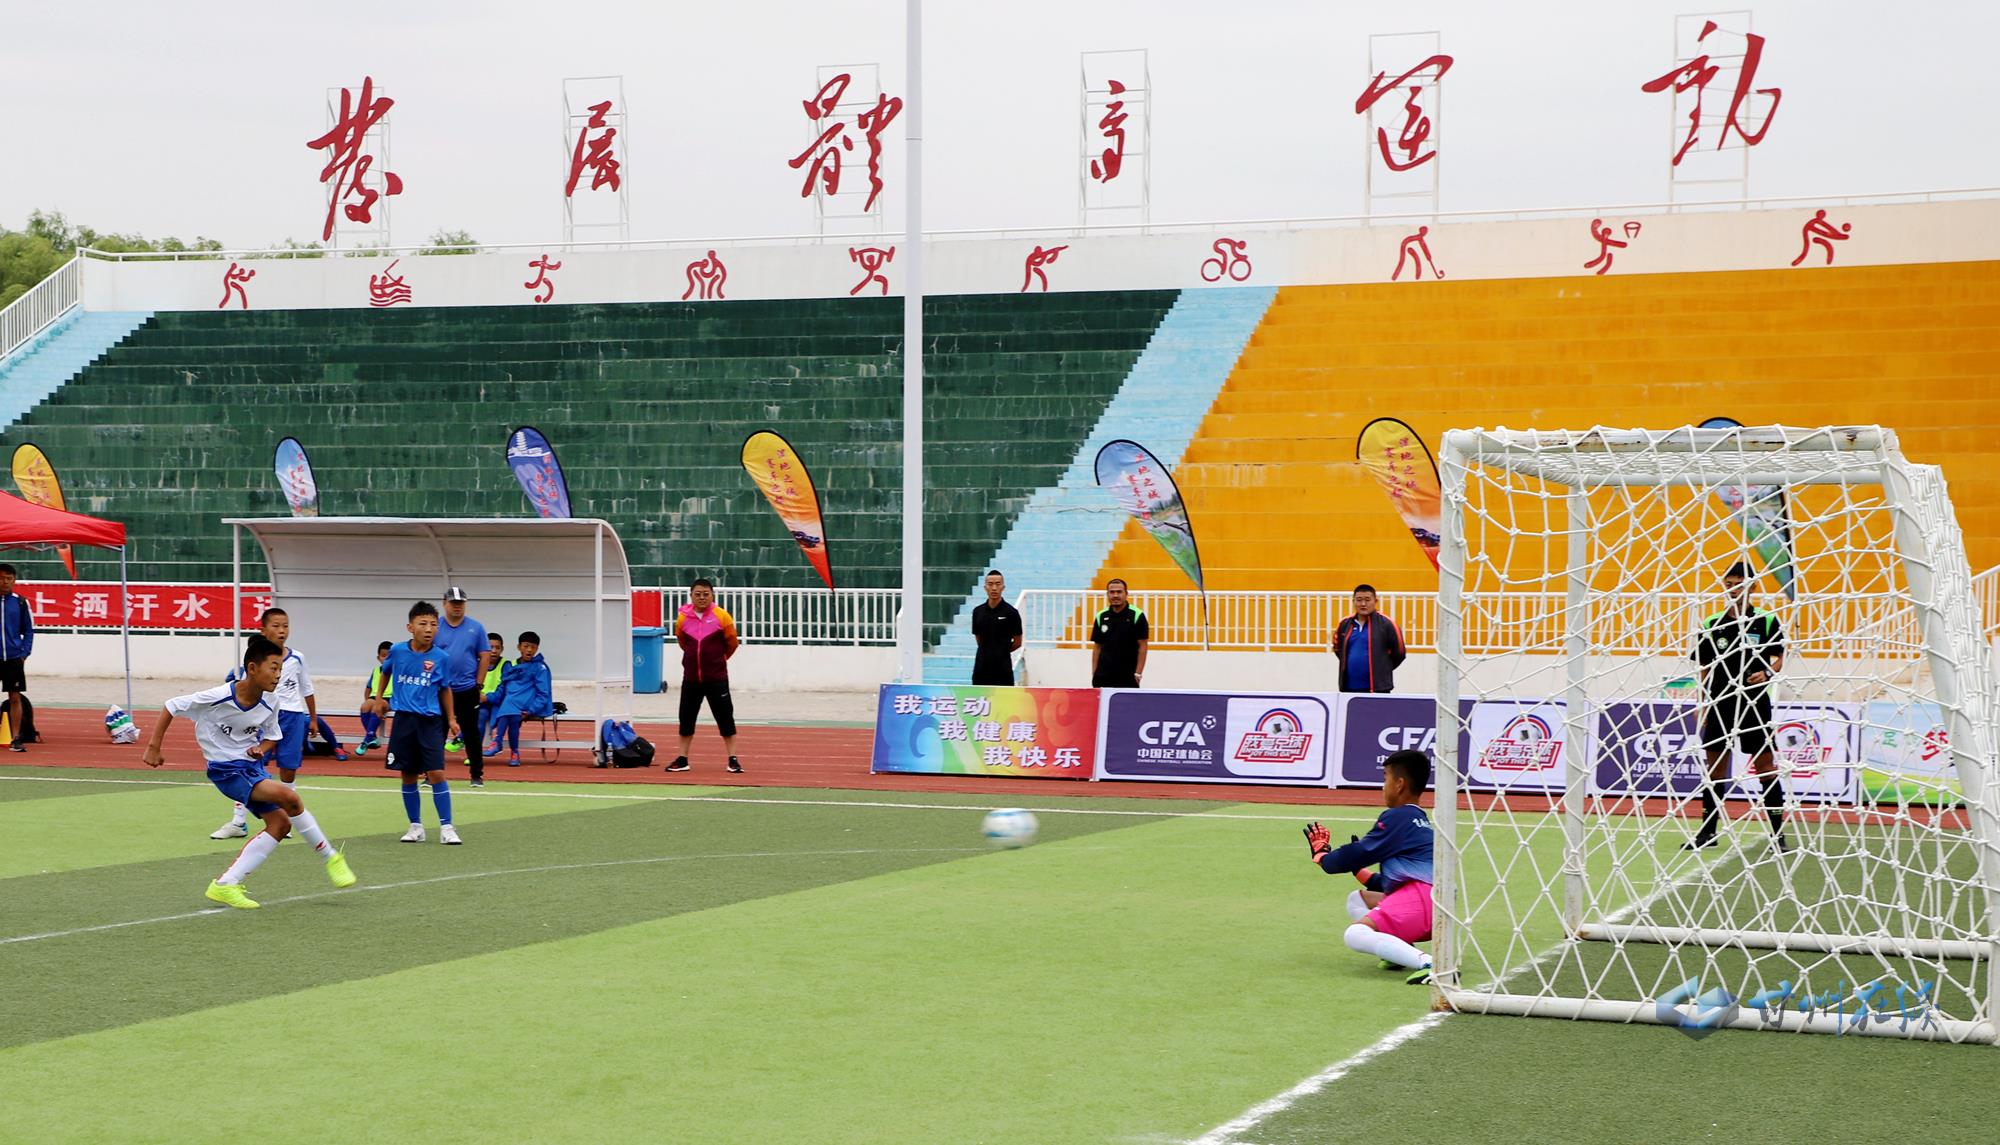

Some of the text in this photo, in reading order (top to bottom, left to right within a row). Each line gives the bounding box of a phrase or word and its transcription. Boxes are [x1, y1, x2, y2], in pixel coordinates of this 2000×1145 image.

[894, 694, 992, 716] 我运动
[939, 720, 1037, 743] 我健康
[1138, 720, 1206, 747] CFA
[984, 746, 1081, 769] 我快乐
[1137, 748, 1213, 761] 中国足球协会
